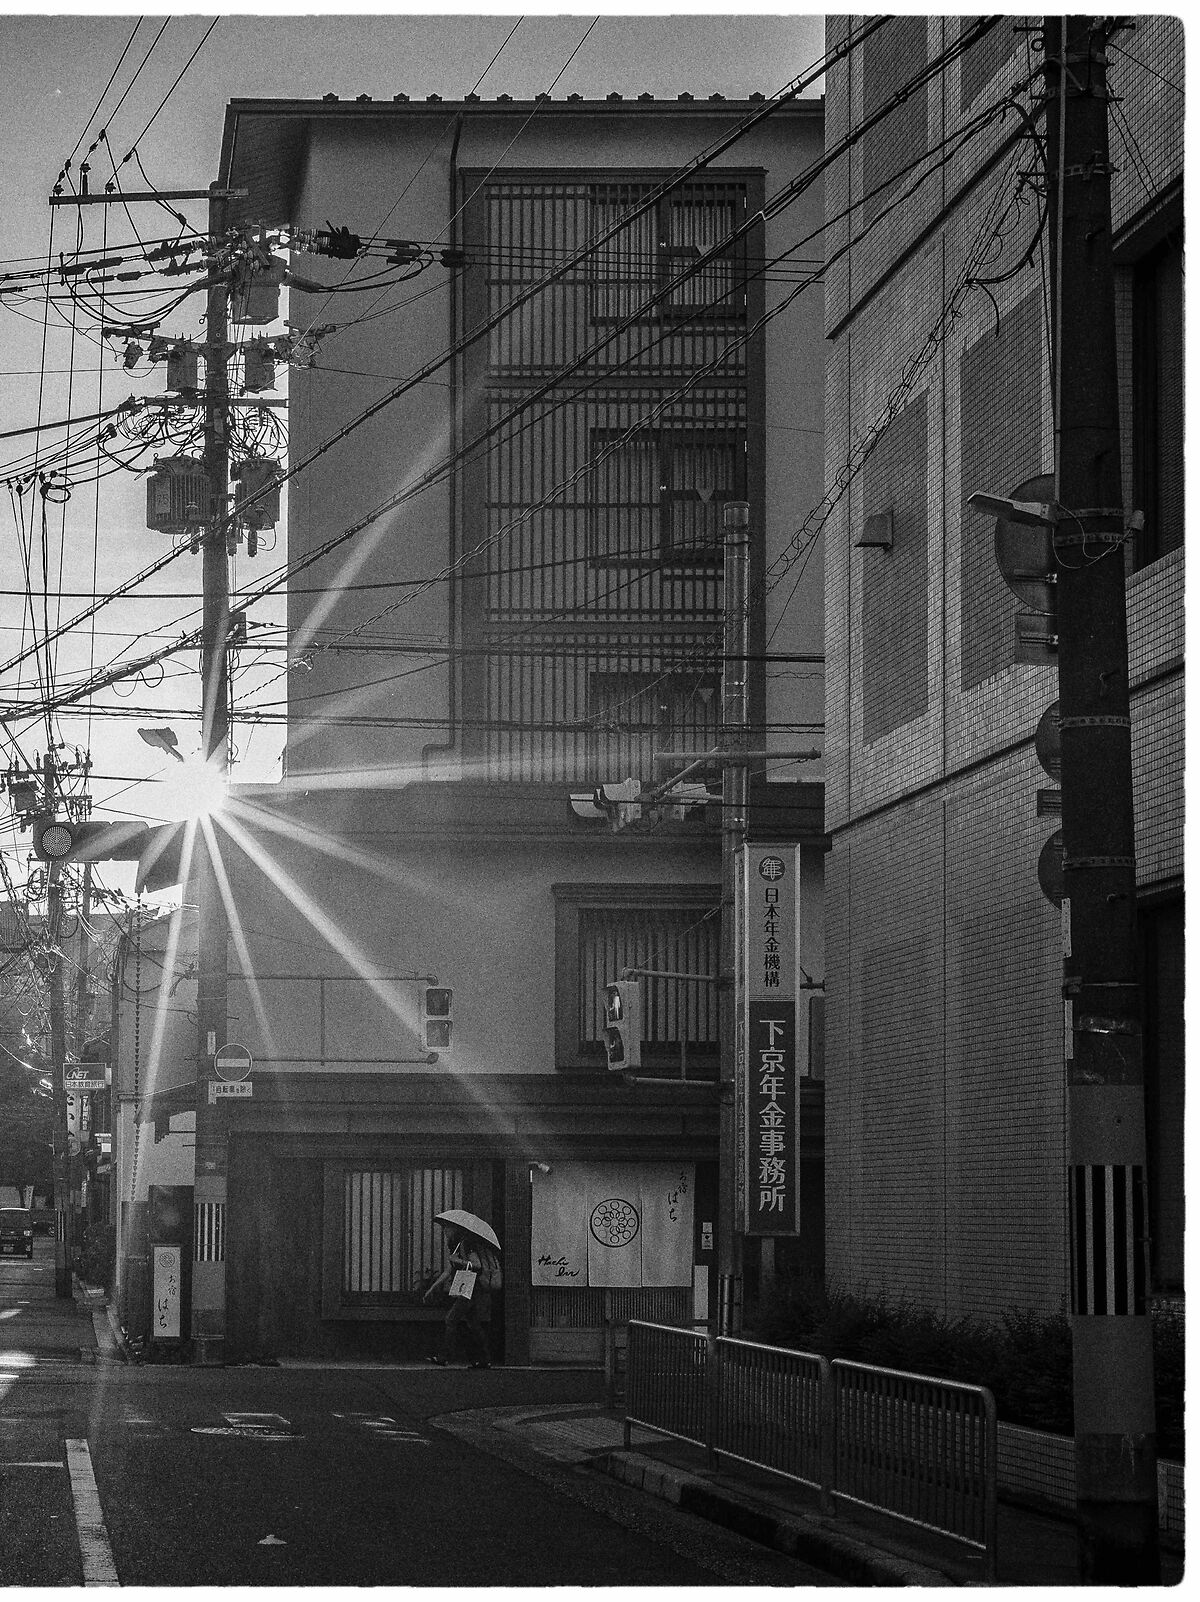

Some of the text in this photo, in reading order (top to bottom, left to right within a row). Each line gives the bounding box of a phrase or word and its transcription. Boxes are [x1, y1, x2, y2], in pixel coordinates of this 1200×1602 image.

[763, 887, 781, 988] 日本年金機構
[758, 1019, 787, 1213] 下京年金事務所
[667, 1191, 678, 1222] はち
[537, 1254, 570, 1266] Hachi
[554, 1266, 581, 1277] Inn
[157, 1297, 170, 1329] はち
